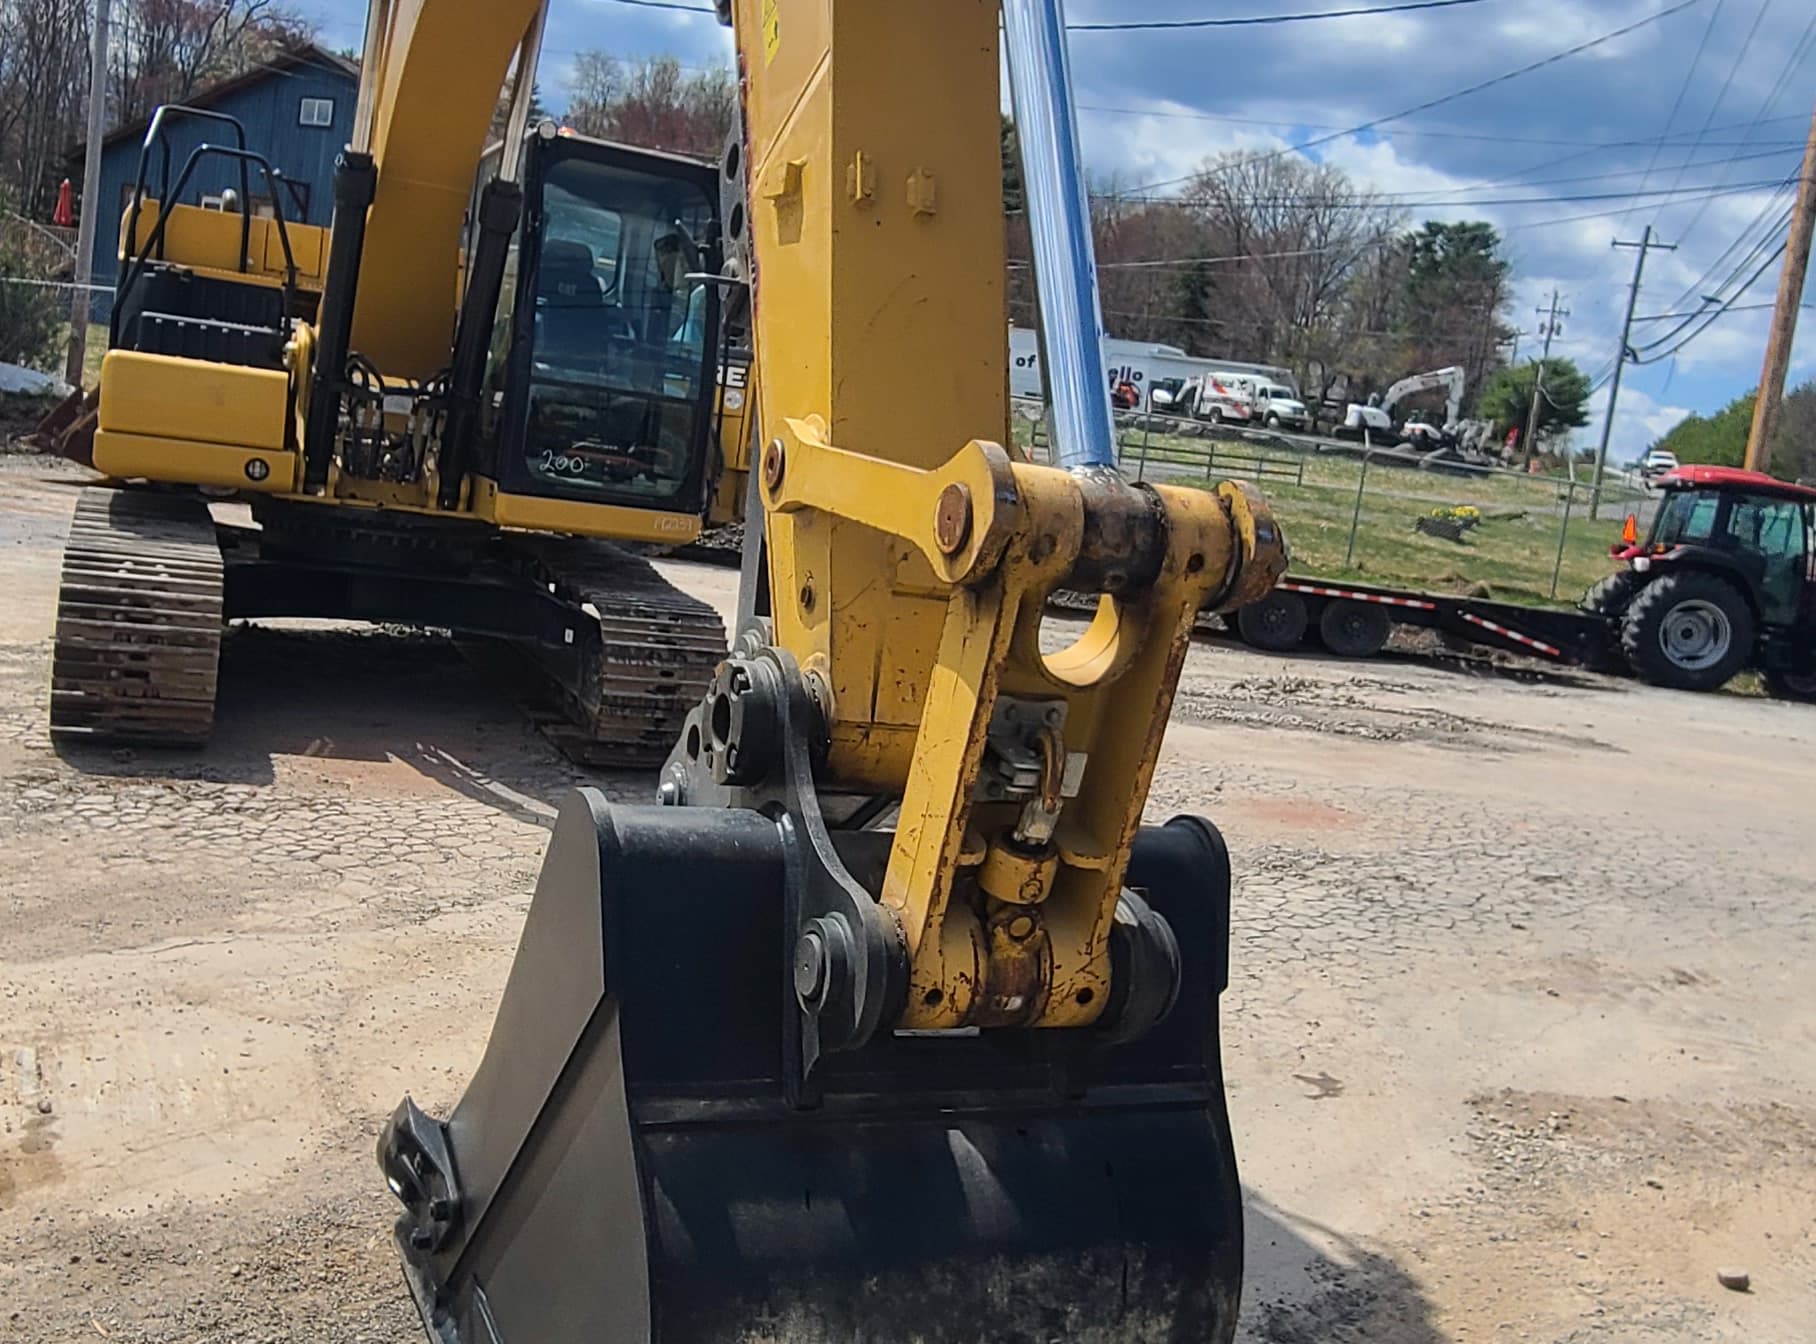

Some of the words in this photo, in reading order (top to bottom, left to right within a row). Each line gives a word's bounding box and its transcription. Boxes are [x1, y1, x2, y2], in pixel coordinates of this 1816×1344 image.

[1016, 354, 1037, 368] of
[1107, 365, 1143, 382] ello
[539, 449, 584, 472] 200
